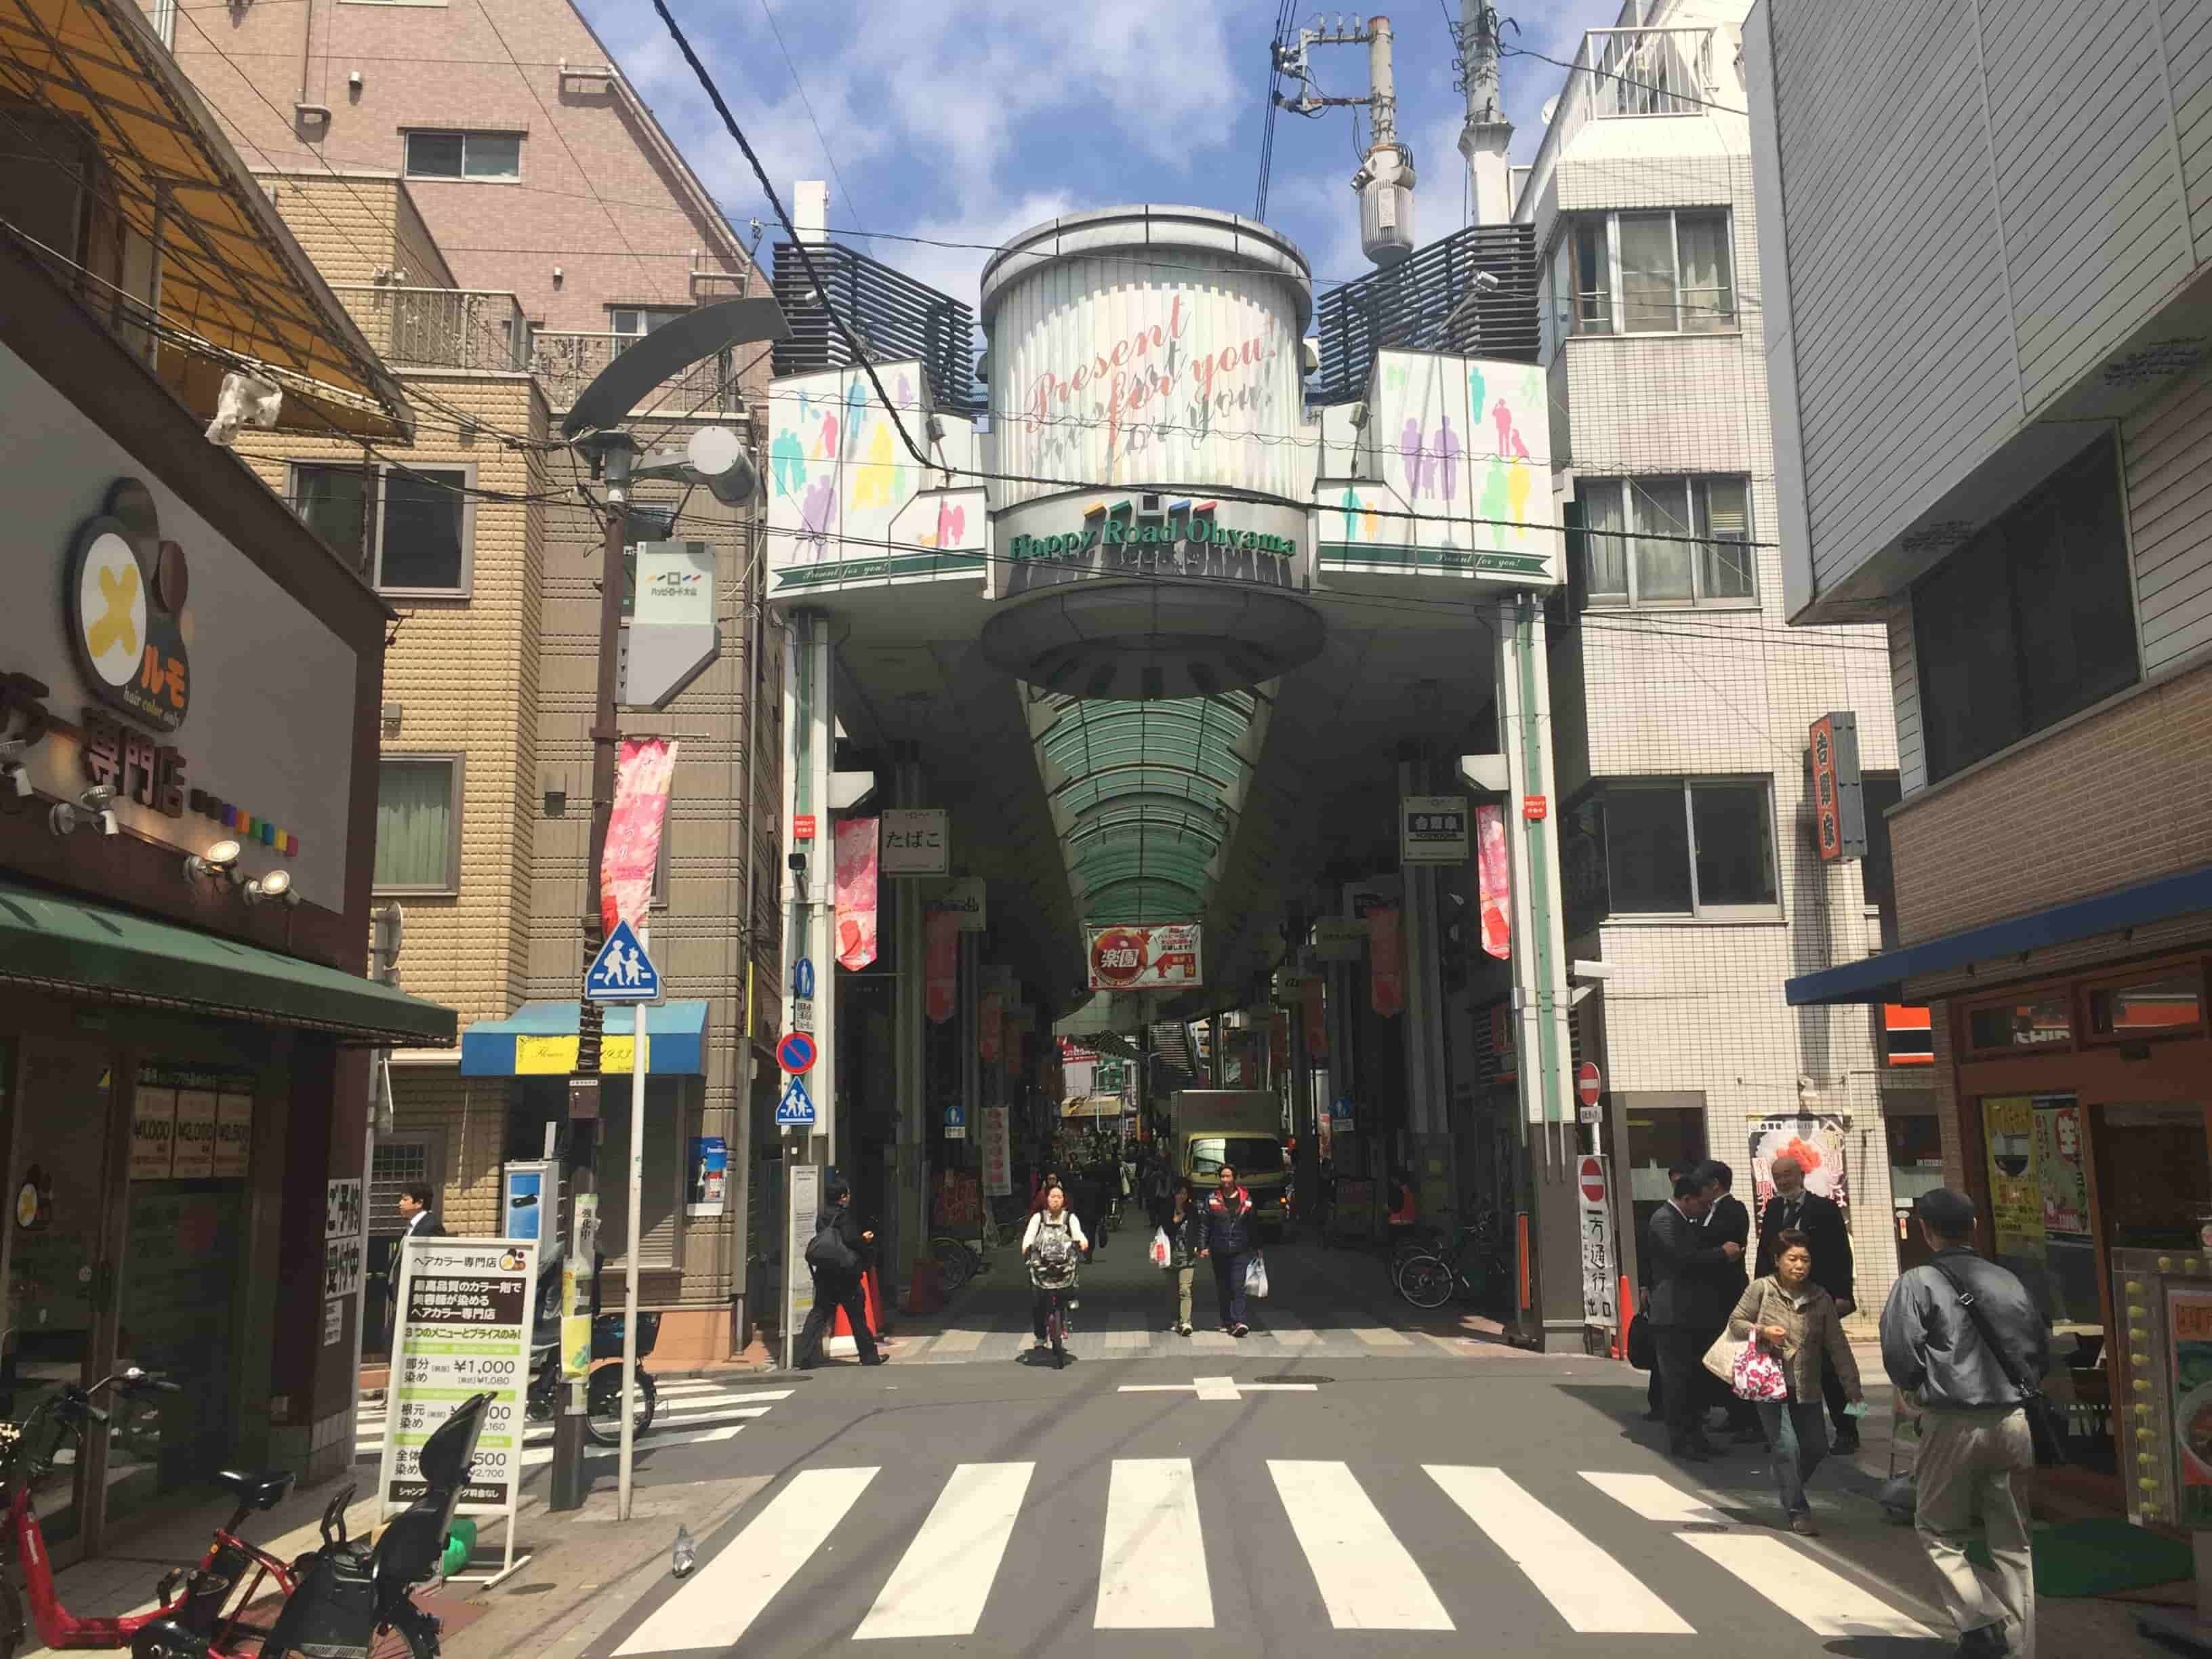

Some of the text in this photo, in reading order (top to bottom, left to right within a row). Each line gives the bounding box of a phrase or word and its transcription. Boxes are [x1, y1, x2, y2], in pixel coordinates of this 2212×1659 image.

[1008, 519, 1296, 560] Happy Road Ohyama
[886, 830, 941, 848] たばこ
[1100, 949, 1140, 969] 楽園
[1586, 1209, 1607, 1292] 一方通行
[414, 1256, 497, 1268] ヘアカラー専門店
[411, 1307, 495, 1319] ヘアカラー専門店
[454, 1360, 515, 1373] ¥1,000
[405, 1371, 428, 1382] 染め
[400, 1418, 423, 1429] 染め
[396, 1463, 418, 1475] 染め
